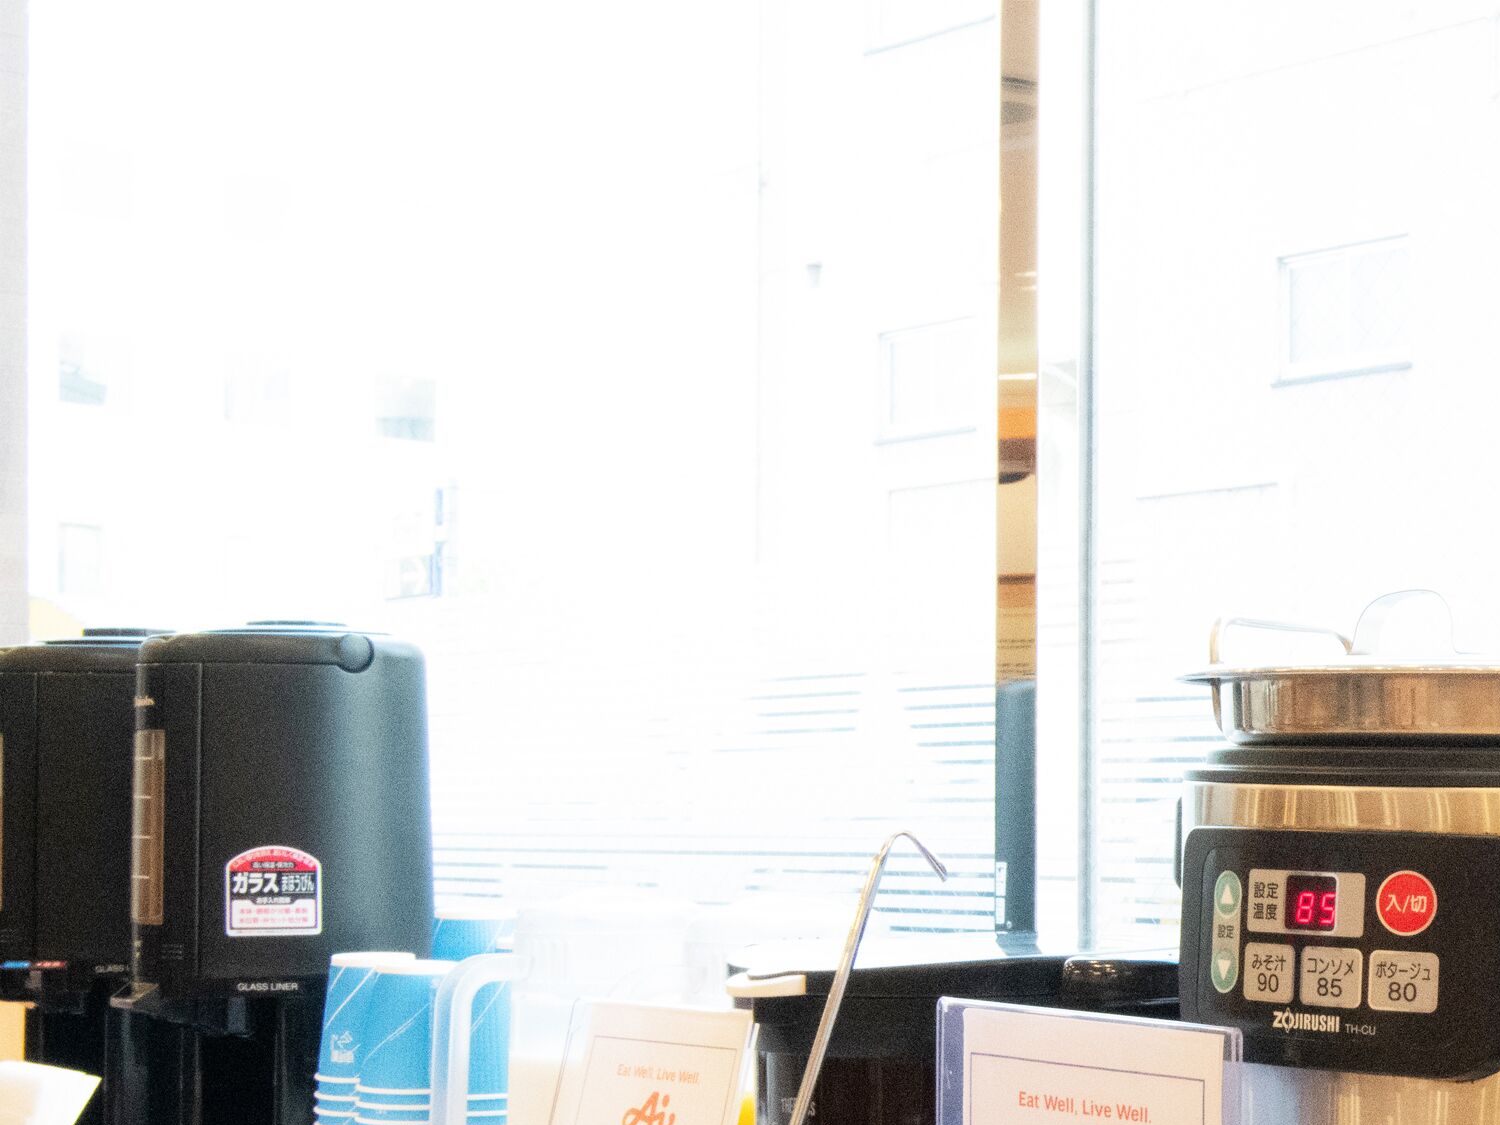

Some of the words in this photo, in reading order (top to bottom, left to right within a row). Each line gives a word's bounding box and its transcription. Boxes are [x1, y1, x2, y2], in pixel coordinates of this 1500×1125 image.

[232, 872, 279, 894] ガラス
[1253, 881, 1279, 899] 設定
[1252, 902, 1278, 921] 温度
[1295, 891, 1335, 925] 85
[1385, 894, 1427, 913] 入/切
[1217, 924, 1234, 939] 設定
[1251, 953, 1286, 971] みそ汁
[1306, 957, 1355, 975] コンソメ
[1375, 961, 1431, 981] ポタージュ
[237, 981, 269, 991] GLASS
[271, 981, 298, 991] LINER
[1257, 973, 1279, 993] 90
[1316, 977, 1342, 997] 85
[1388, 981, 1417, 1002] 80
[1272, 1008, 1340, 1033] ZOJIRUSHI
[1345, 1023, 1376, 1036] TH-CU
[1018, 1091, 1040, 1109] Eat
[1044, 1094, 1078, 1116] Well,
[1082, 1100, 1112, 1118] Live
[1116, 1103, 1152, 1124] Well.
